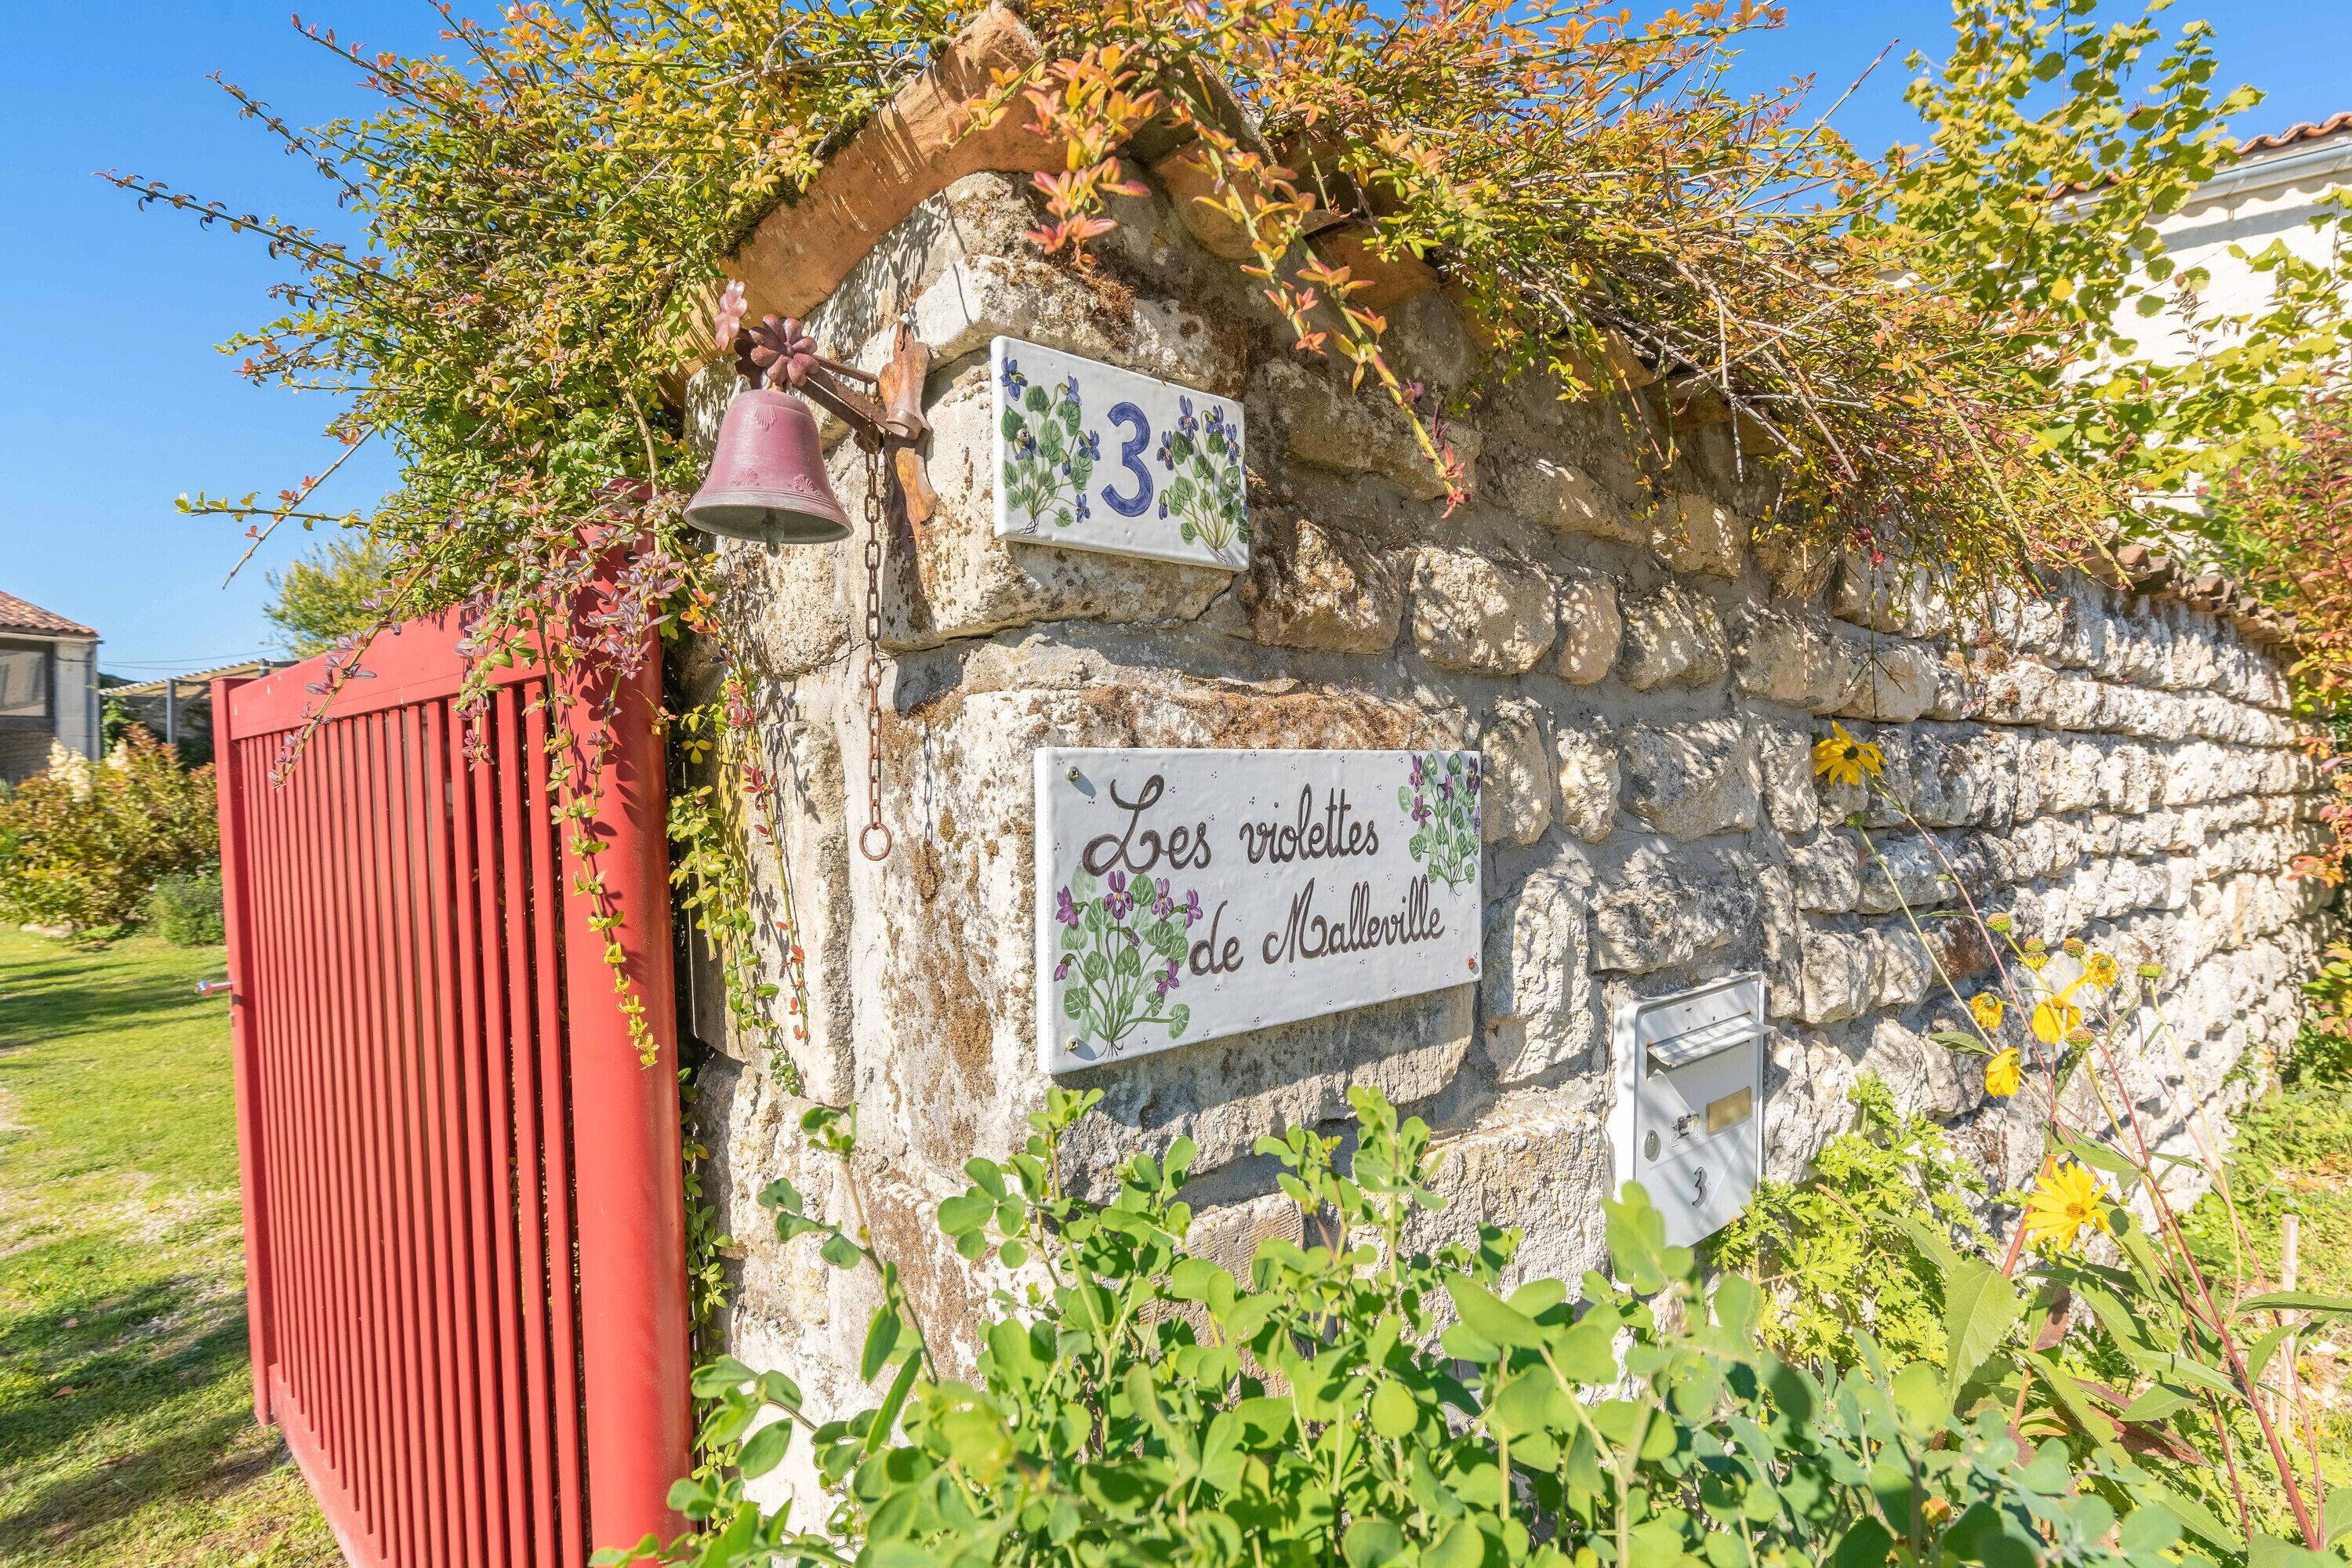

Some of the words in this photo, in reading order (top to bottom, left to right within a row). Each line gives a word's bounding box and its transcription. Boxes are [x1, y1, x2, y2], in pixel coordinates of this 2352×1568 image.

[1101, 401, 1153, 517] 3
[1082, 773, 1212, 877] Les
[1239, 782, 1380, 865] violettes
[1188, 898, 1244, 976] de
[1261, 873, 1446, 966] Malleville
[1691, 1166, 1708, 1209] 3
